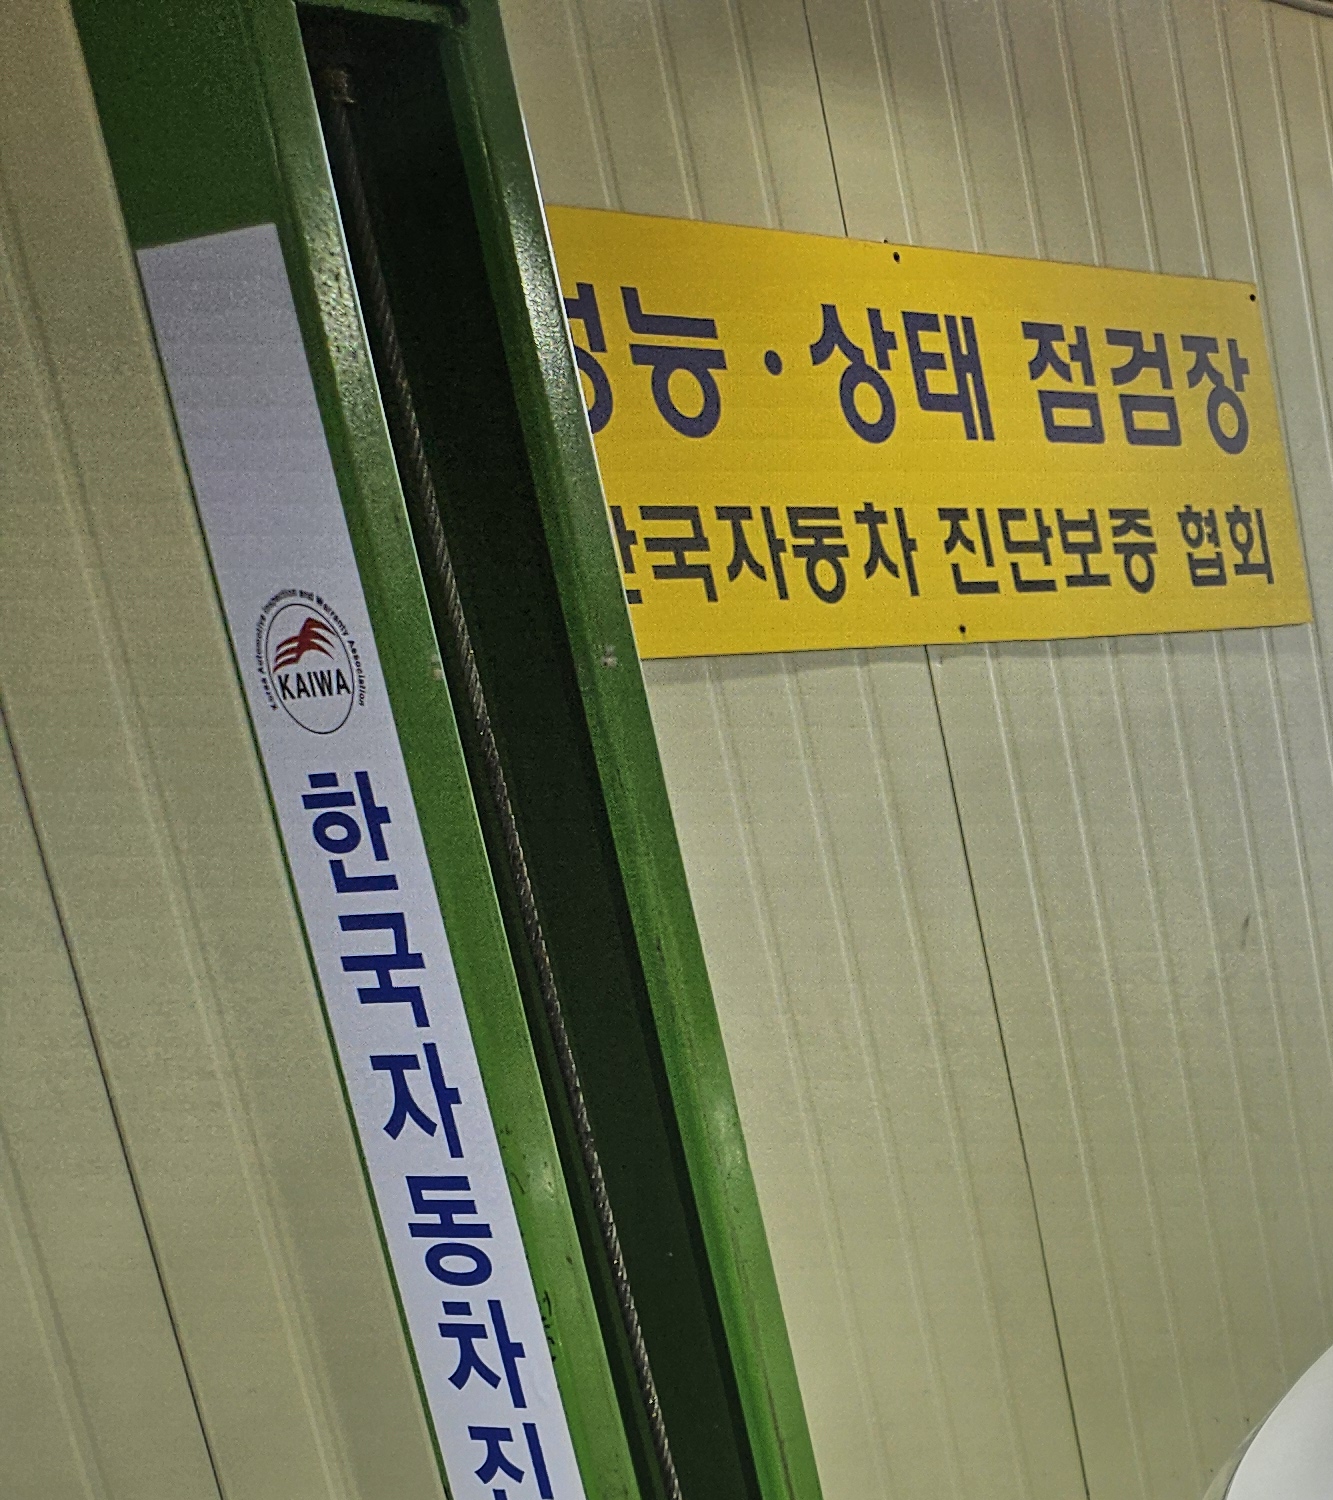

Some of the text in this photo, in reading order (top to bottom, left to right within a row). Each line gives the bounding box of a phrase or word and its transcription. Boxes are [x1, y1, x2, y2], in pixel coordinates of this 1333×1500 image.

[1021, 320, 1250, 455] 점검장
[937, 506, 1158, 596] 진단보증
[1177, 502, 1275, 588] 협회
[277, 667, 352, 701] KAIWA
